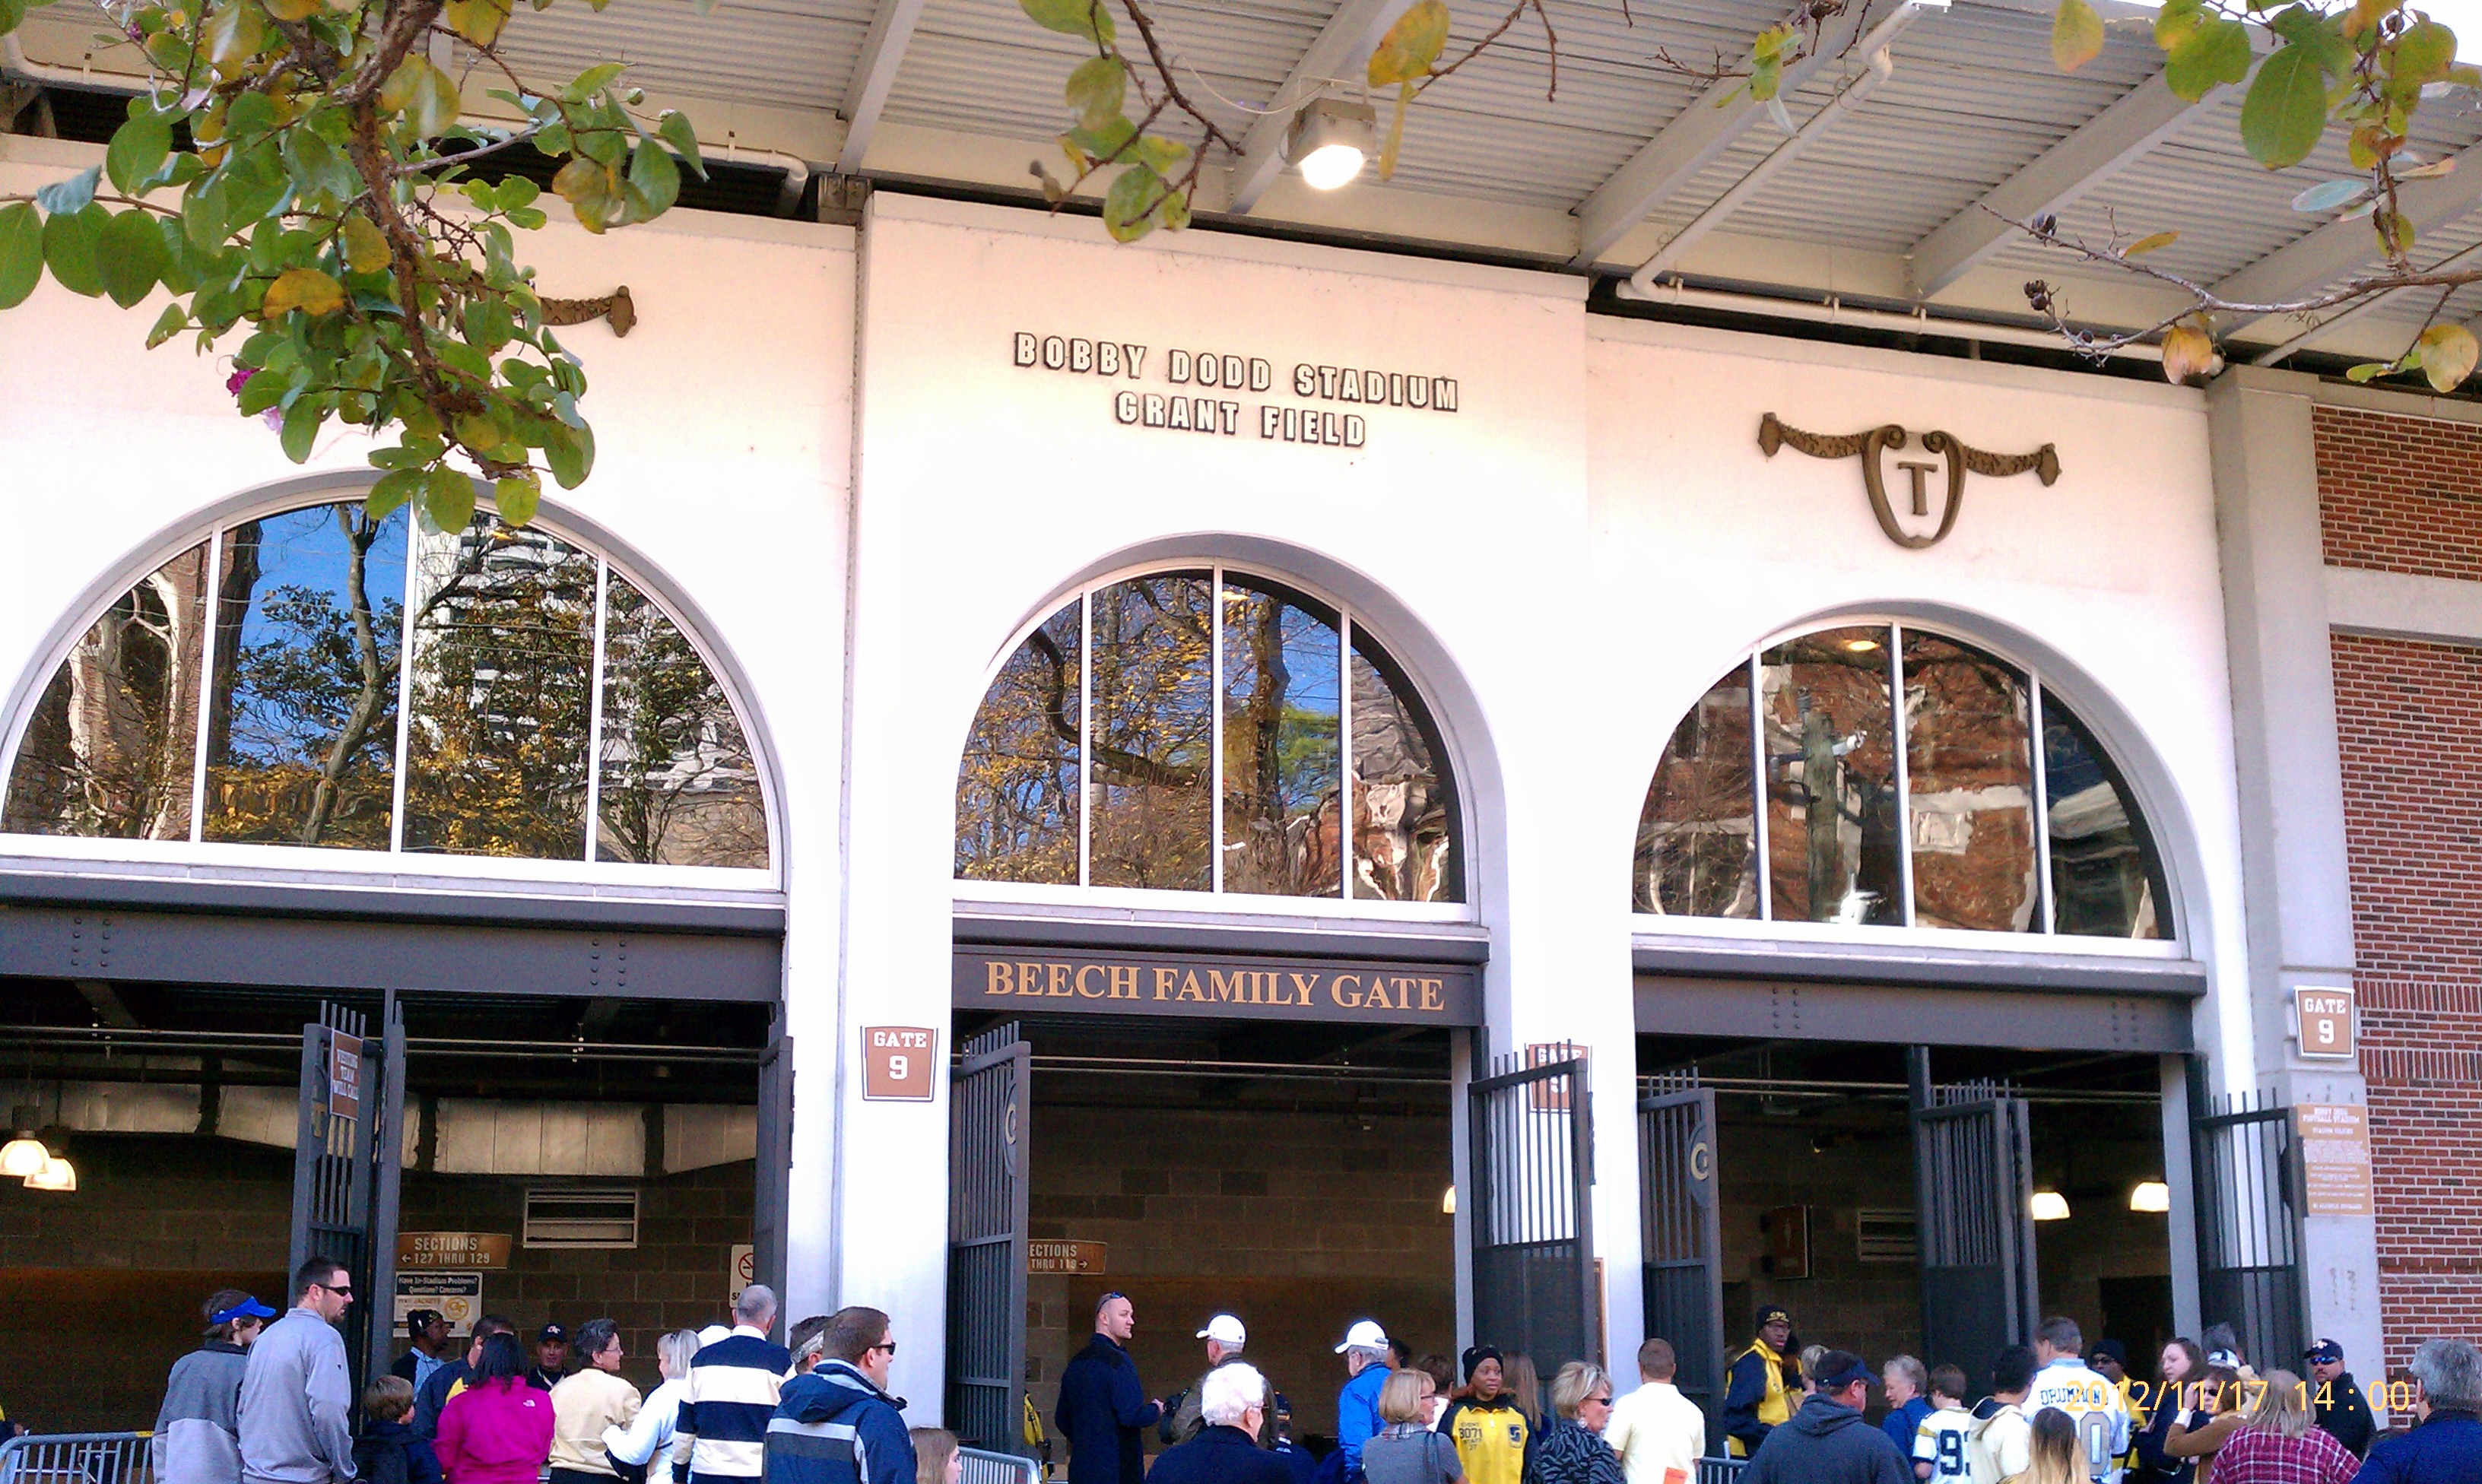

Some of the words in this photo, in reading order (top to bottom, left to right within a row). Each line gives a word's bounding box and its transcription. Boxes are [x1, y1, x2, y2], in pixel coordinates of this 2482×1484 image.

[1014, 331, 1147, 379] BOBBY
[1169, 349, 1271, 392] DODD
[1294, 363, 1458, 412] STADIUM
[1115, 390, 1239, 435] GRANT
[1261, 405, 1366, 448] FIELD
[1897, 461, 1938, 515] T
[984, 962, 1141, 1000] BEECH
[1152, 968, 1320, 1007] FAMILY
[1331, 974, 1445, 1011] GATE
[2304, 997, 2346, 1015] GATE
[874, 1031, 928, 1048] GATE
[2319, 1019, 2334, 1045] 9
[888, 1055, 909, 1080] 9
[414, 1237, 478, 1251] SECTIONS
[1029, 1244, 1078, 1257] ECTIONS
[414, 1253, 433, 1264] 127
[439, 1253, 465, 1264] THRU
[471, 1254, 490, 1264] 129
[1031, 1259, 1055, 1269] THRU
[1059, 1258, 1078, 1270] 119
[2040, 1387, 2109, 1405] DRUMMON
[1458, 1428, 1482, 1439] 3071
